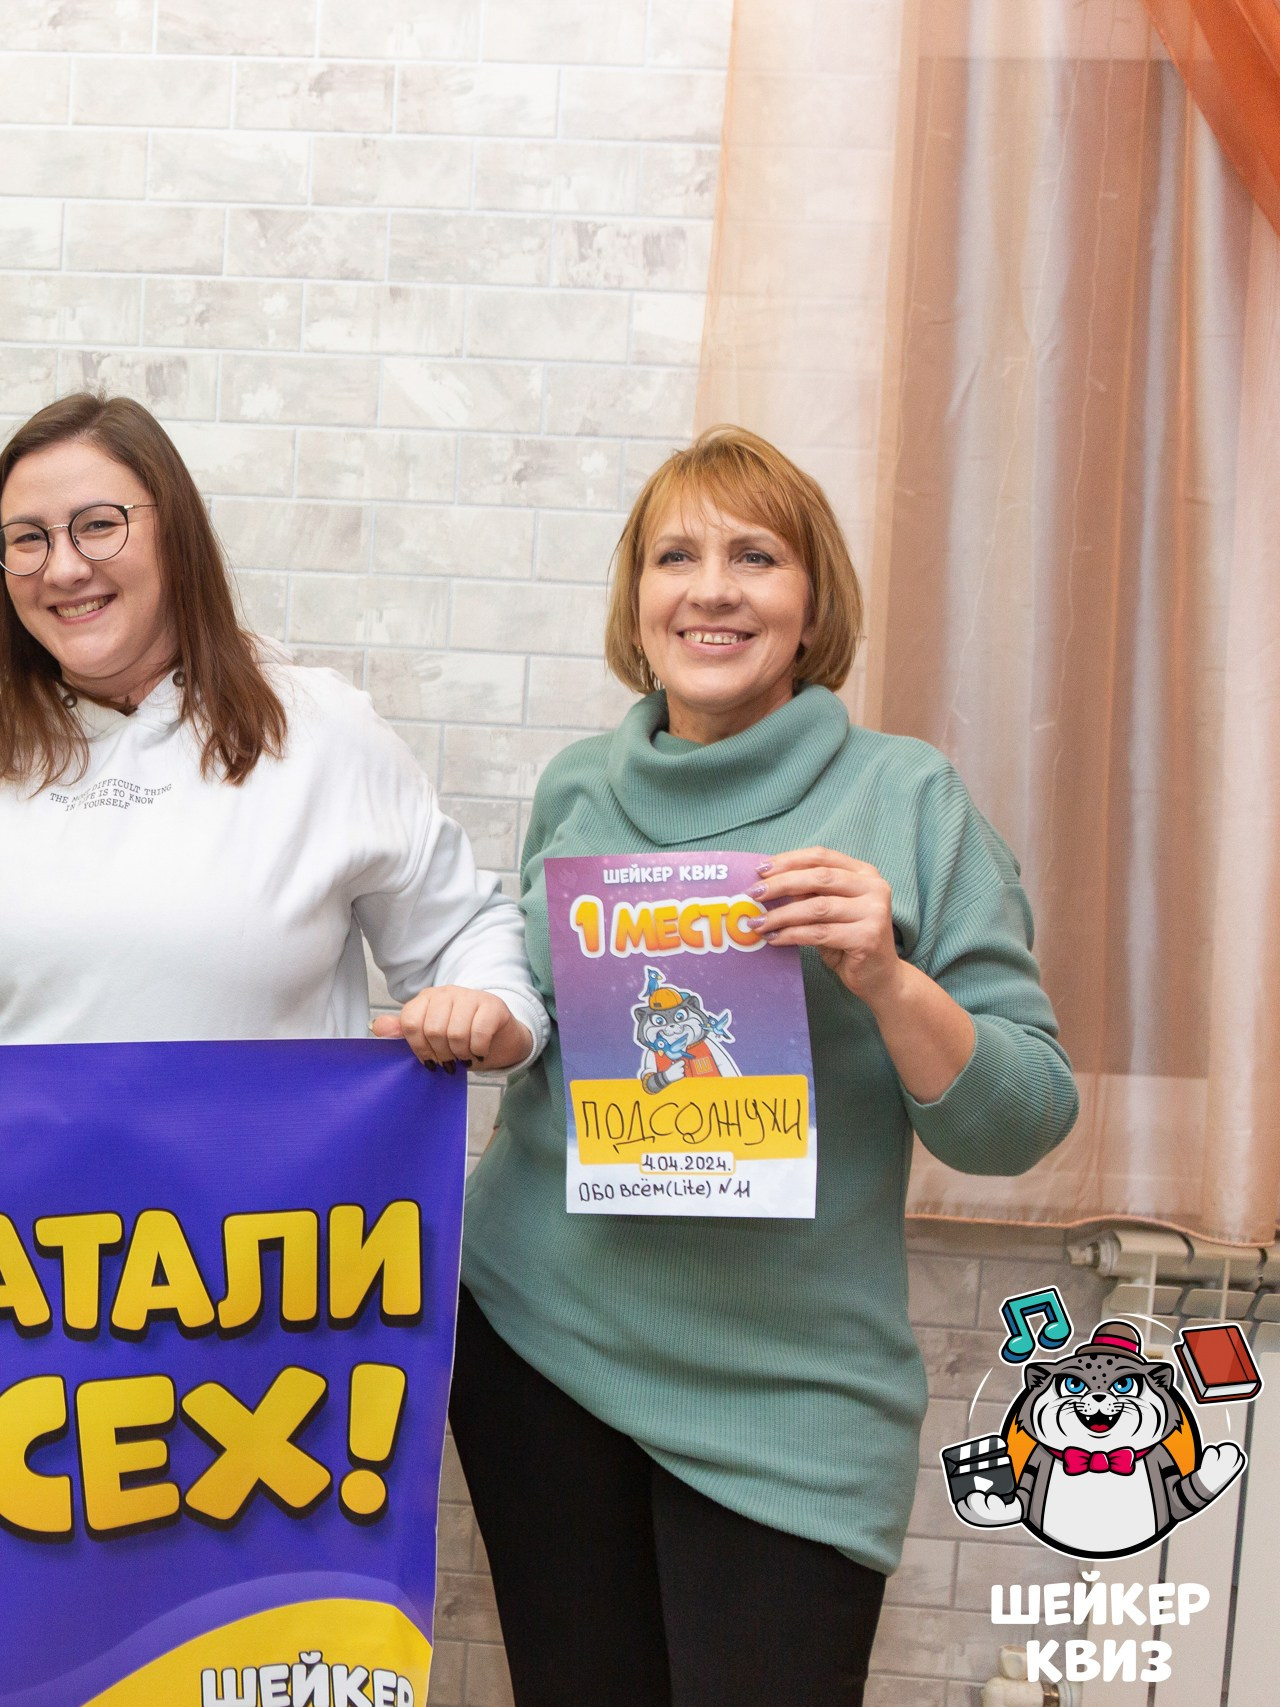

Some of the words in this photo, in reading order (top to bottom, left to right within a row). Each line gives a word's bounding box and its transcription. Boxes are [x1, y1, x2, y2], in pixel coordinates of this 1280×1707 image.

[50, 792, 69, 804] THE
[92, 778, 141, 794] DIFFICULT
[144, 783, 173, 796] THING
[65, 803, 75, 812] IN
[98, 788, 109, 798] IS
[113, 788, 126, 798] TO
[129, 793, 155, 805] KNOW
[83, 797, 131, 810] YOURSELF
[603, 863, 673, 885] ШЕЙКЕР
[679, 864, 729, 883] КВИЗ
[573, 899, 601, 954] 1
[615, 899, 765, 952] МЕСТО
